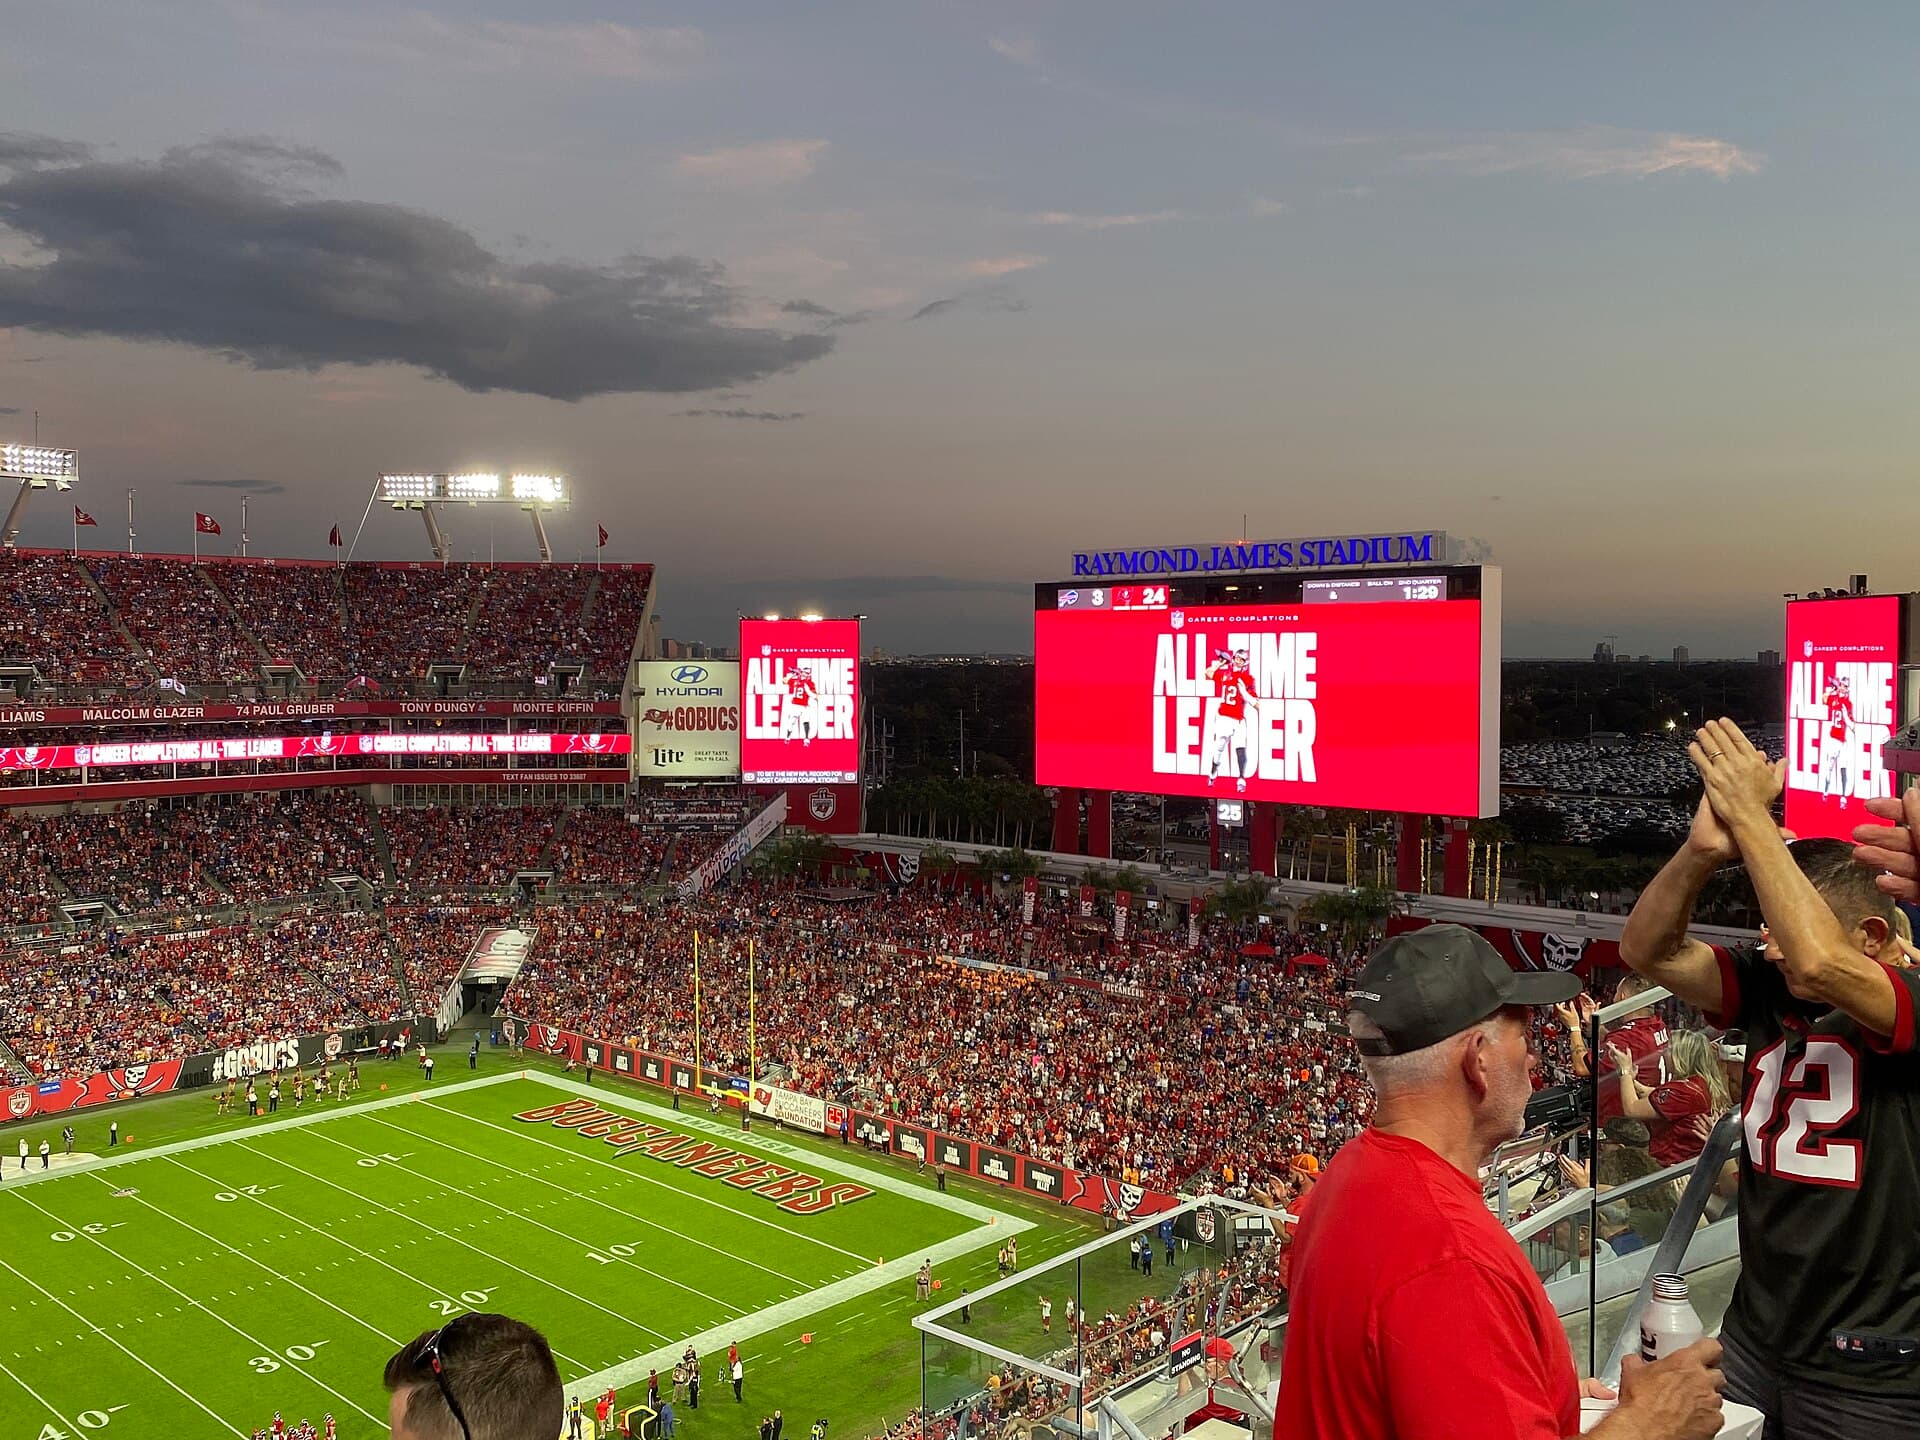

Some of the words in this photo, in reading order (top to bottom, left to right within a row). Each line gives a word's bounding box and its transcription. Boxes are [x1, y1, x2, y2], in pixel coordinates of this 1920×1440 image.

[1073, 547, 1198, 576] RAYMOND
[1203, 541, 1292, 571] JAMES
[1300, 534, 1433, 567] STADIUM
[1412, 578, 1442, 586] QUARTER
[1091, 589, 1104, 606] 3
[1142, 587, 1166, 604] 24
[1403, 585, 1439, 600] 1:29
[1229, 614, 1299, 622] COMPLETIONS
[656, 687, 723, 697] HYUNDAI
[82, 708, 150, 721] MALCOLM
[153, 706, 204, 719] GLAZER
[236, 705, 250, 716] 74
[252, 704, 283, 716] PAUL
[286, 703, 335, 716] GRUBER
[400, 702, 432, 714] TONY
[434, 702, 476, 714] DUNGY
[513, 703, 554, 714] MONTE
[557, 703, 594, 714] KIFFIN
[666, 705, 738, 731] #GOBUCS
[374, 735, 407, 752] CAREER
[516, 735, 551, 752] LEADER
[1153, 695, 1317, 783] LEADER
[92, 745, 130, 765] CAREER
[131, 742, 200, 763] COMPLETIONS
[247, 739, 283, 757] LEADER
[653, 748, 684, 767] Lite
[502, 773, 519, 781] TEXT
[520, 773, 533, 781] FAN
[533, 773, 558, 781] ISSUES
[560, 773, 569, 781] TO
[1218, 803, 1242, 821] 25
[775, 1089, 798, 1102] TAMPA
[800, 1096, 813, 1106] BAY
[775, 1098, 822, 1121] BUCCANEERS
[828, 1106, 842, 1125] 25
[1742, 1036, 1862, 1188] 12
[681, 1116, 714, 1130] END
[716, 1128, 797, 1154] RACISM
[356, 1152, 401, 1168] 10
[512, 1097, 876, 1215] BUCCANEERS
[214, 1184, 267, 1202] 20
[50, 1222, 108, 1242] 30
[585, 1244, 636, 1266] 10
[429, 1290, 489, 1316] 20
[248, 1345, 316, 1374] 30
[1181, 1347, 1191, 1359] NO
[1171, 1353, 1202, 1375] STANDING
[37, 1410, 110, 1440] 40
